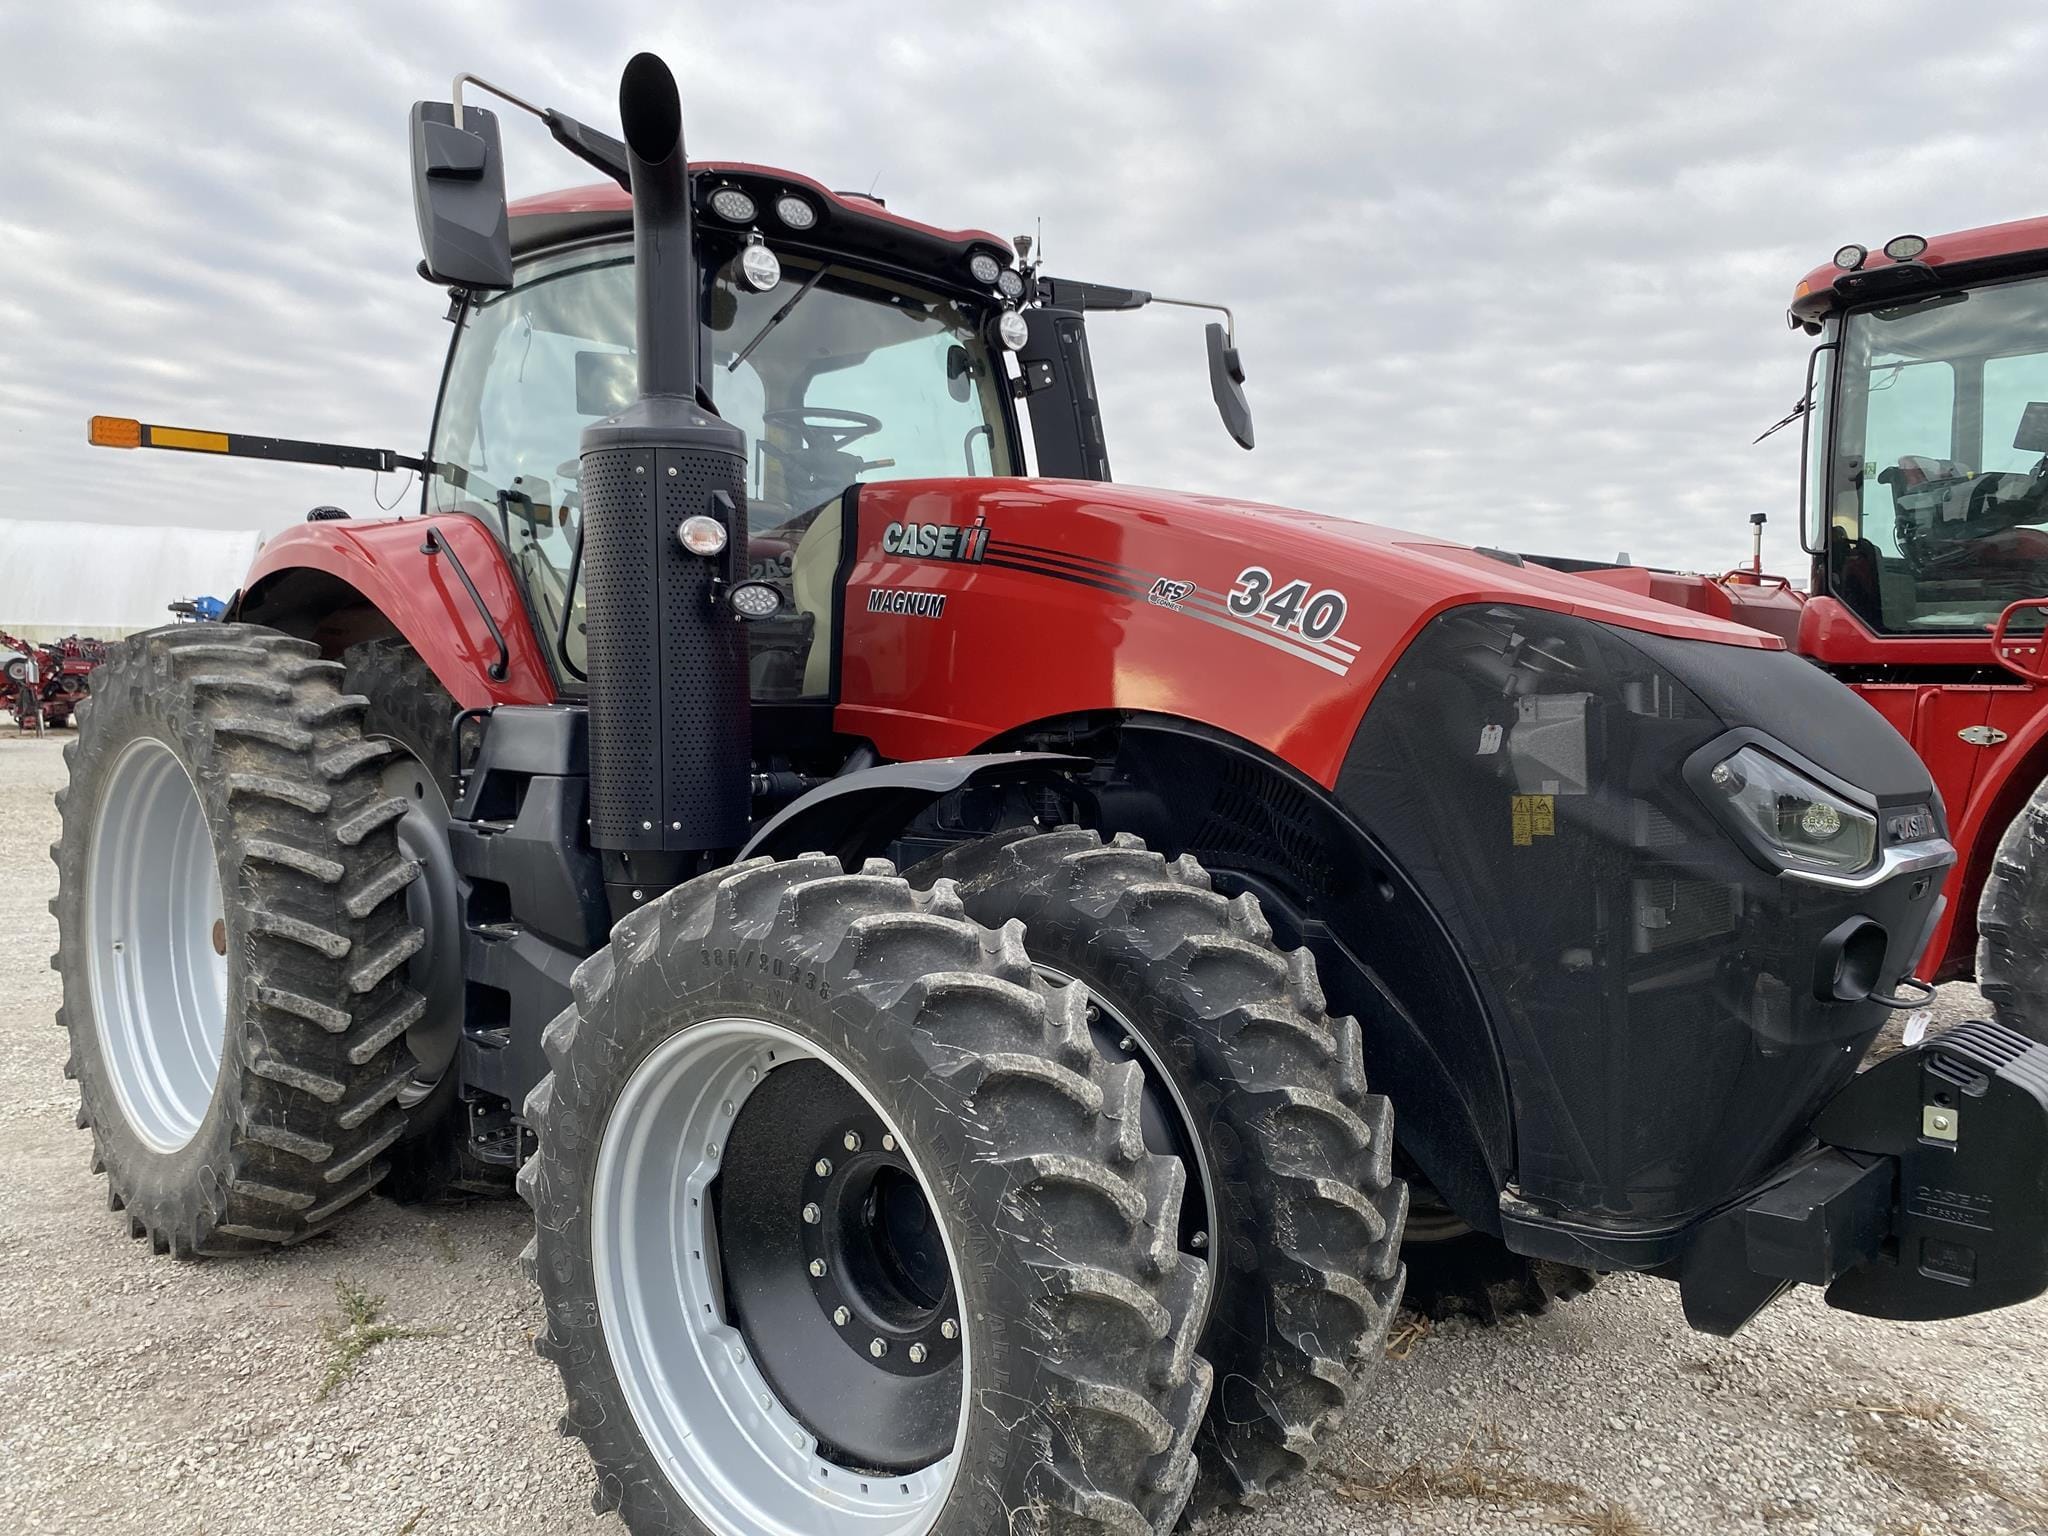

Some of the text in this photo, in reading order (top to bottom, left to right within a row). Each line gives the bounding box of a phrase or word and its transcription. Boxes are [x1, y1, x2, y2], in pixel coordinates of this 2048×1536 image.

[883, 521, 959, 559] CASE
[867, 589, 946, 618] MAGNUM
[1149, 577, 1187, 601] AFS
[1227, 566, 1347, 643] 340
